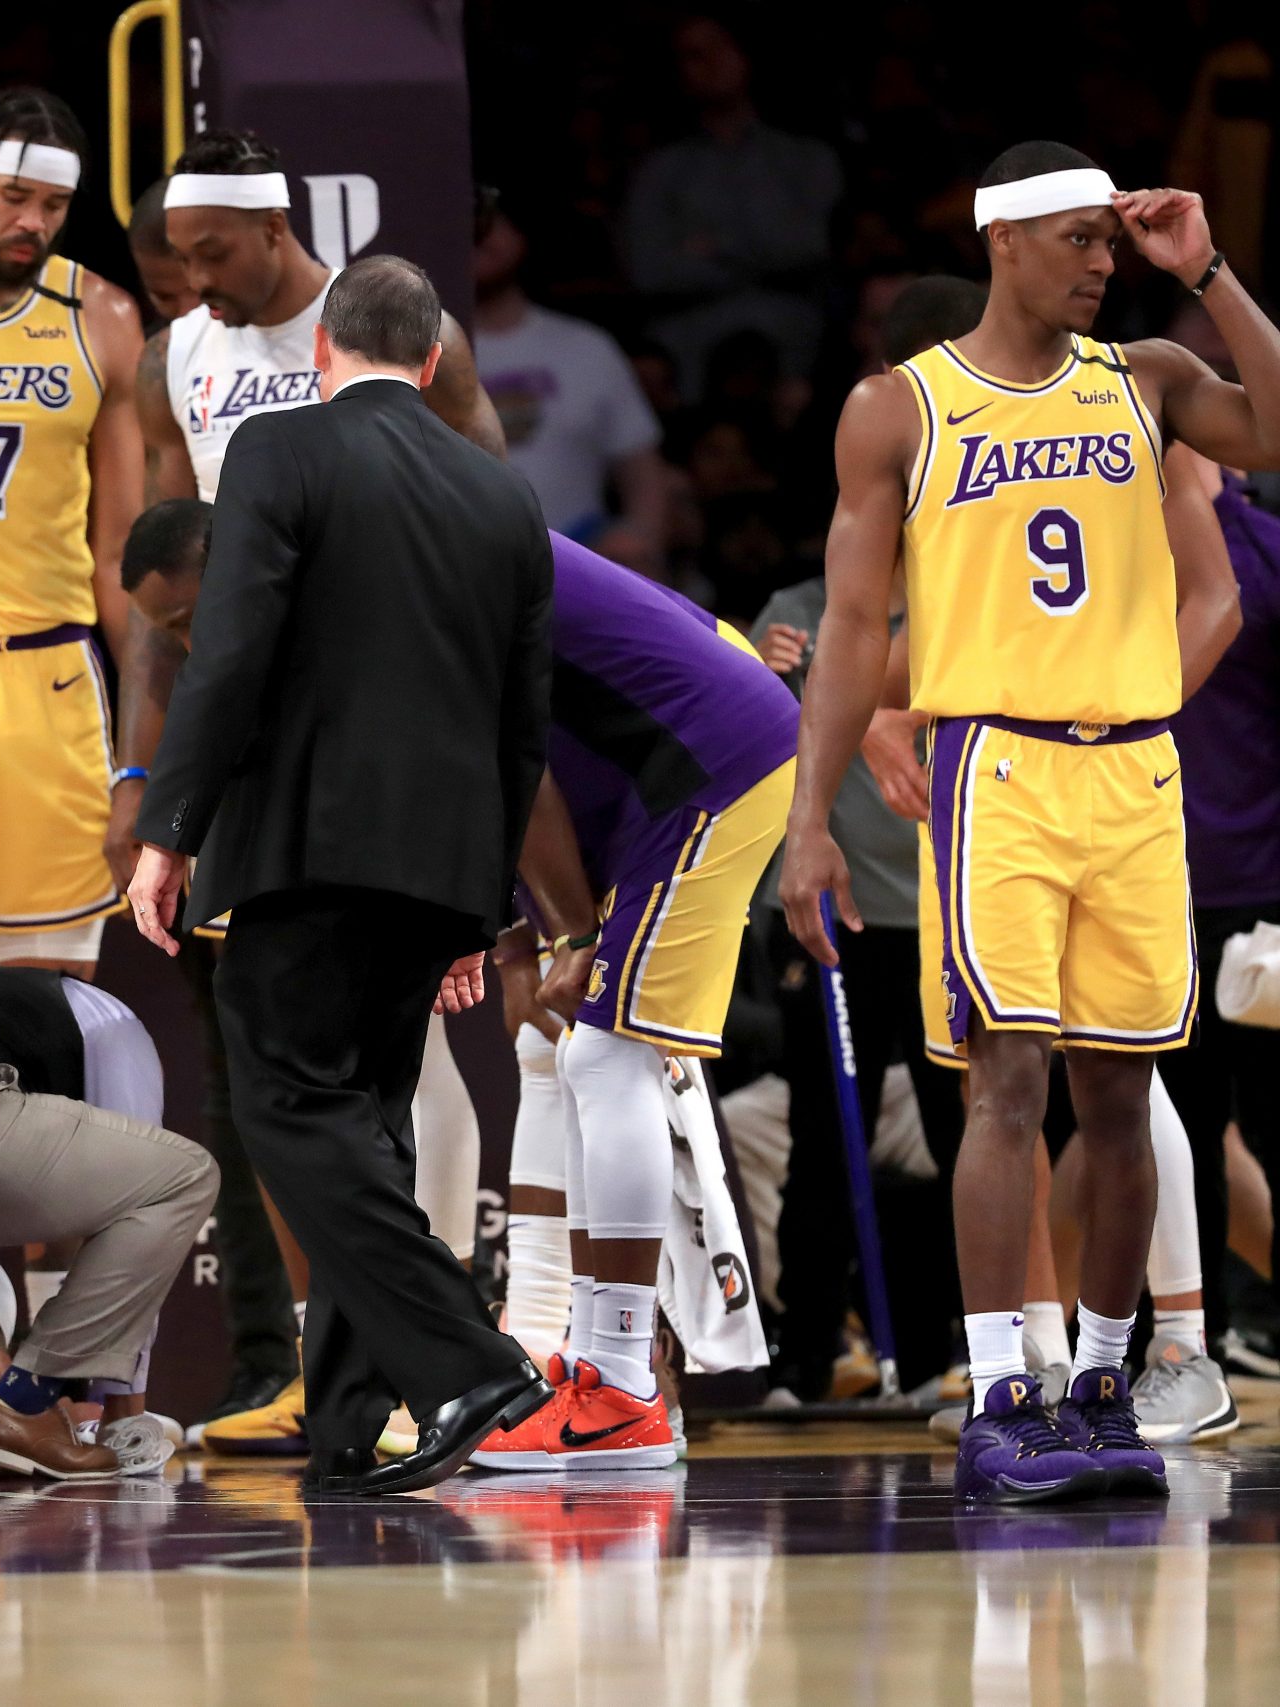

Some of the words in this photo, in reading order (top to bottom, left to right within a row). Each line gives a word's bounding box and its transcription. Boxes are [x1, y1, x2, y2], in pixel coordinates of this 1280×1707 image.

[23, 326, 66, 339] wish
[1072, 390, 1119, 405] wish
[944, 432, 1136, 509] LAKERS
[1026, 506, 1090, 616] 9
[1100, 1375, 1116, 1400] R
